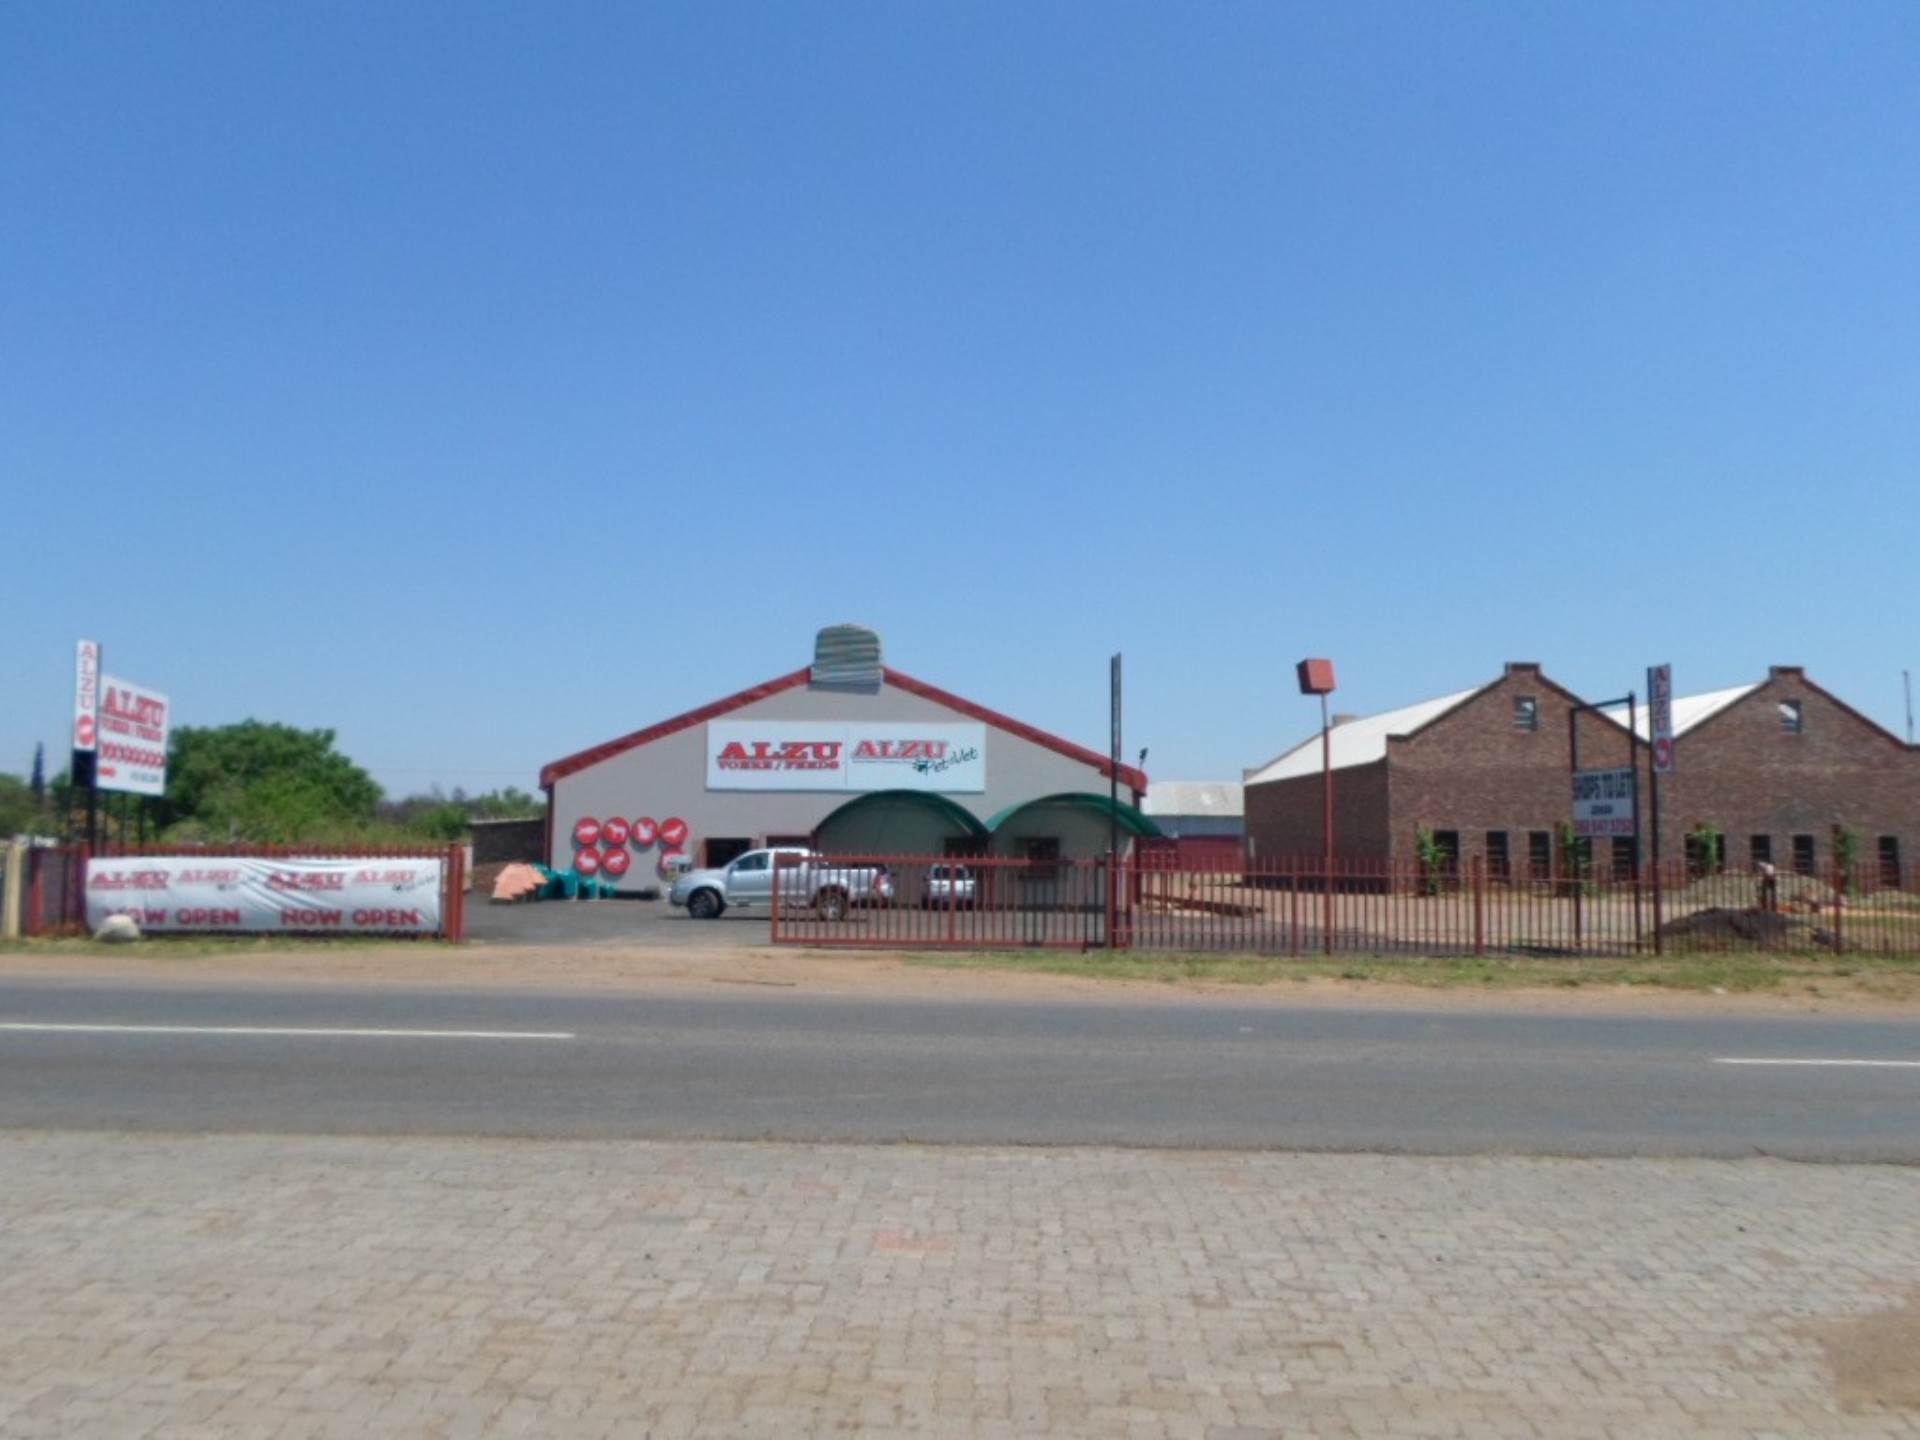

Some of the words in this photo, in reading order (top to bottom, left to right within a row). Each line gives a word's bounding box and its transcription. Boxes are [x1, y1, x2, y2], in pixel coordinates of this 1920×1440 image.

[717, 742, 842, 760] ALZU
[853, 740, 948, 759] ALZU
[176, 908, 240, 924] OPEN
[280, 908, 342, 925] NOW
[352, 908, 421, 926] OPEN
